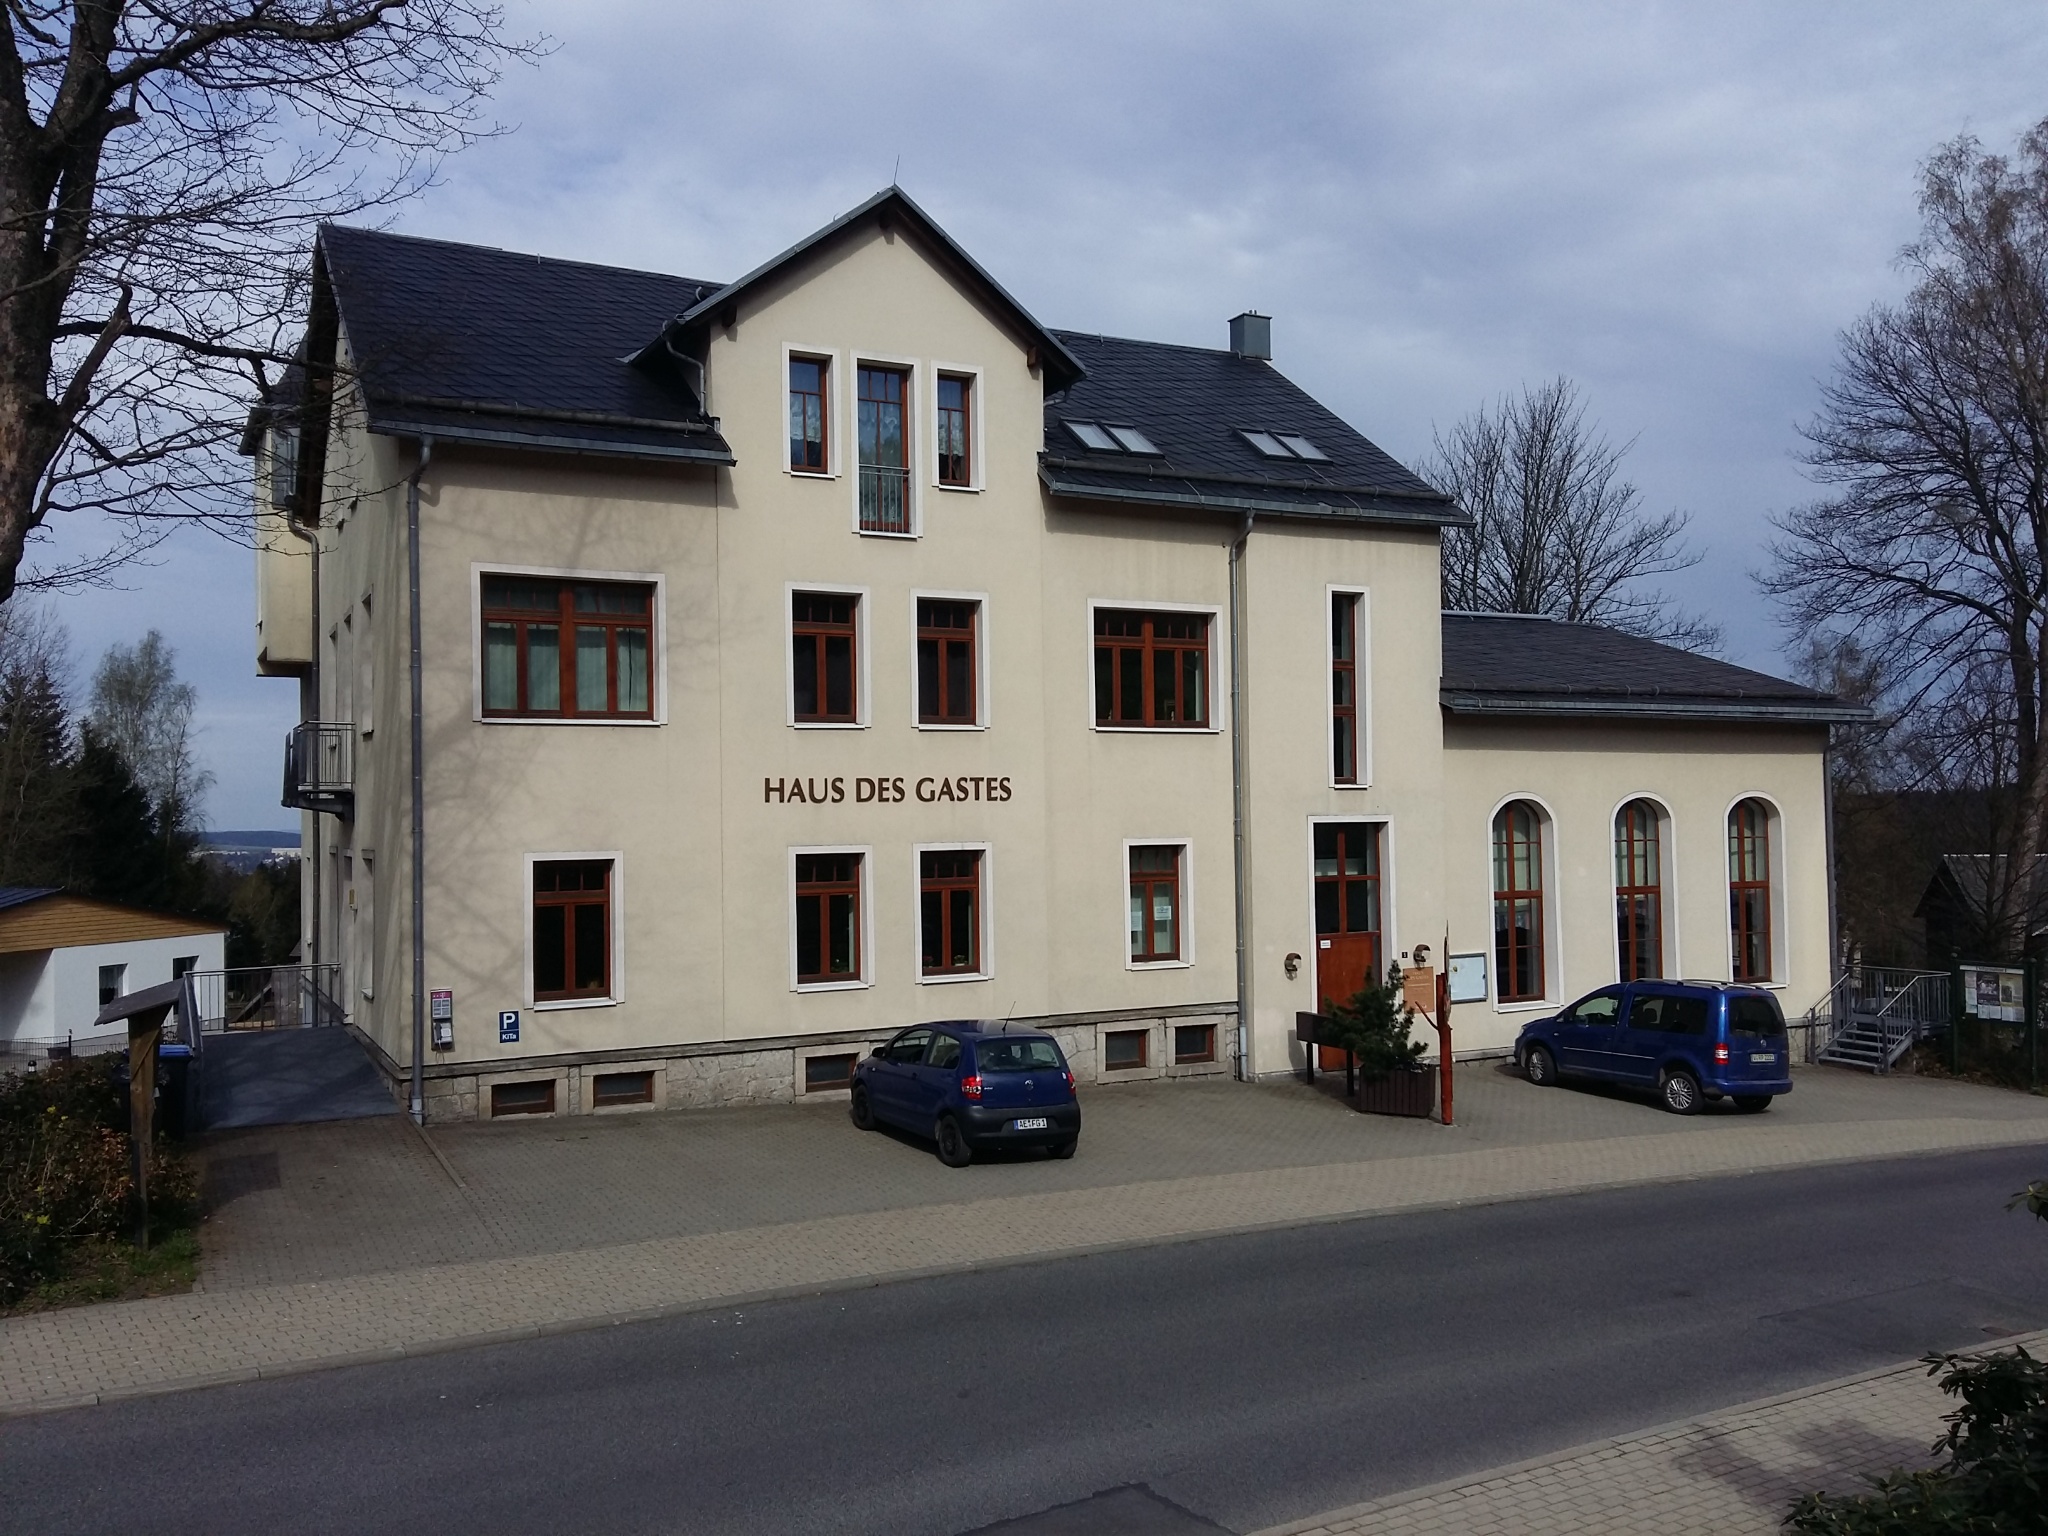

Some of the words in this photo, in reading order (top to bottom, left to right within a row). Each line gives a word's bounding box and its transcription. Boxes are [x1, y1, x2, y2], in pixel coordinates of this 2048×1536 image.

[764, 777, 845, 804] HAUS
[855, 777, 906, 803] DES
[915, 776, 1012, 802] GASTES
[503, 1012, 516, 1029] P
